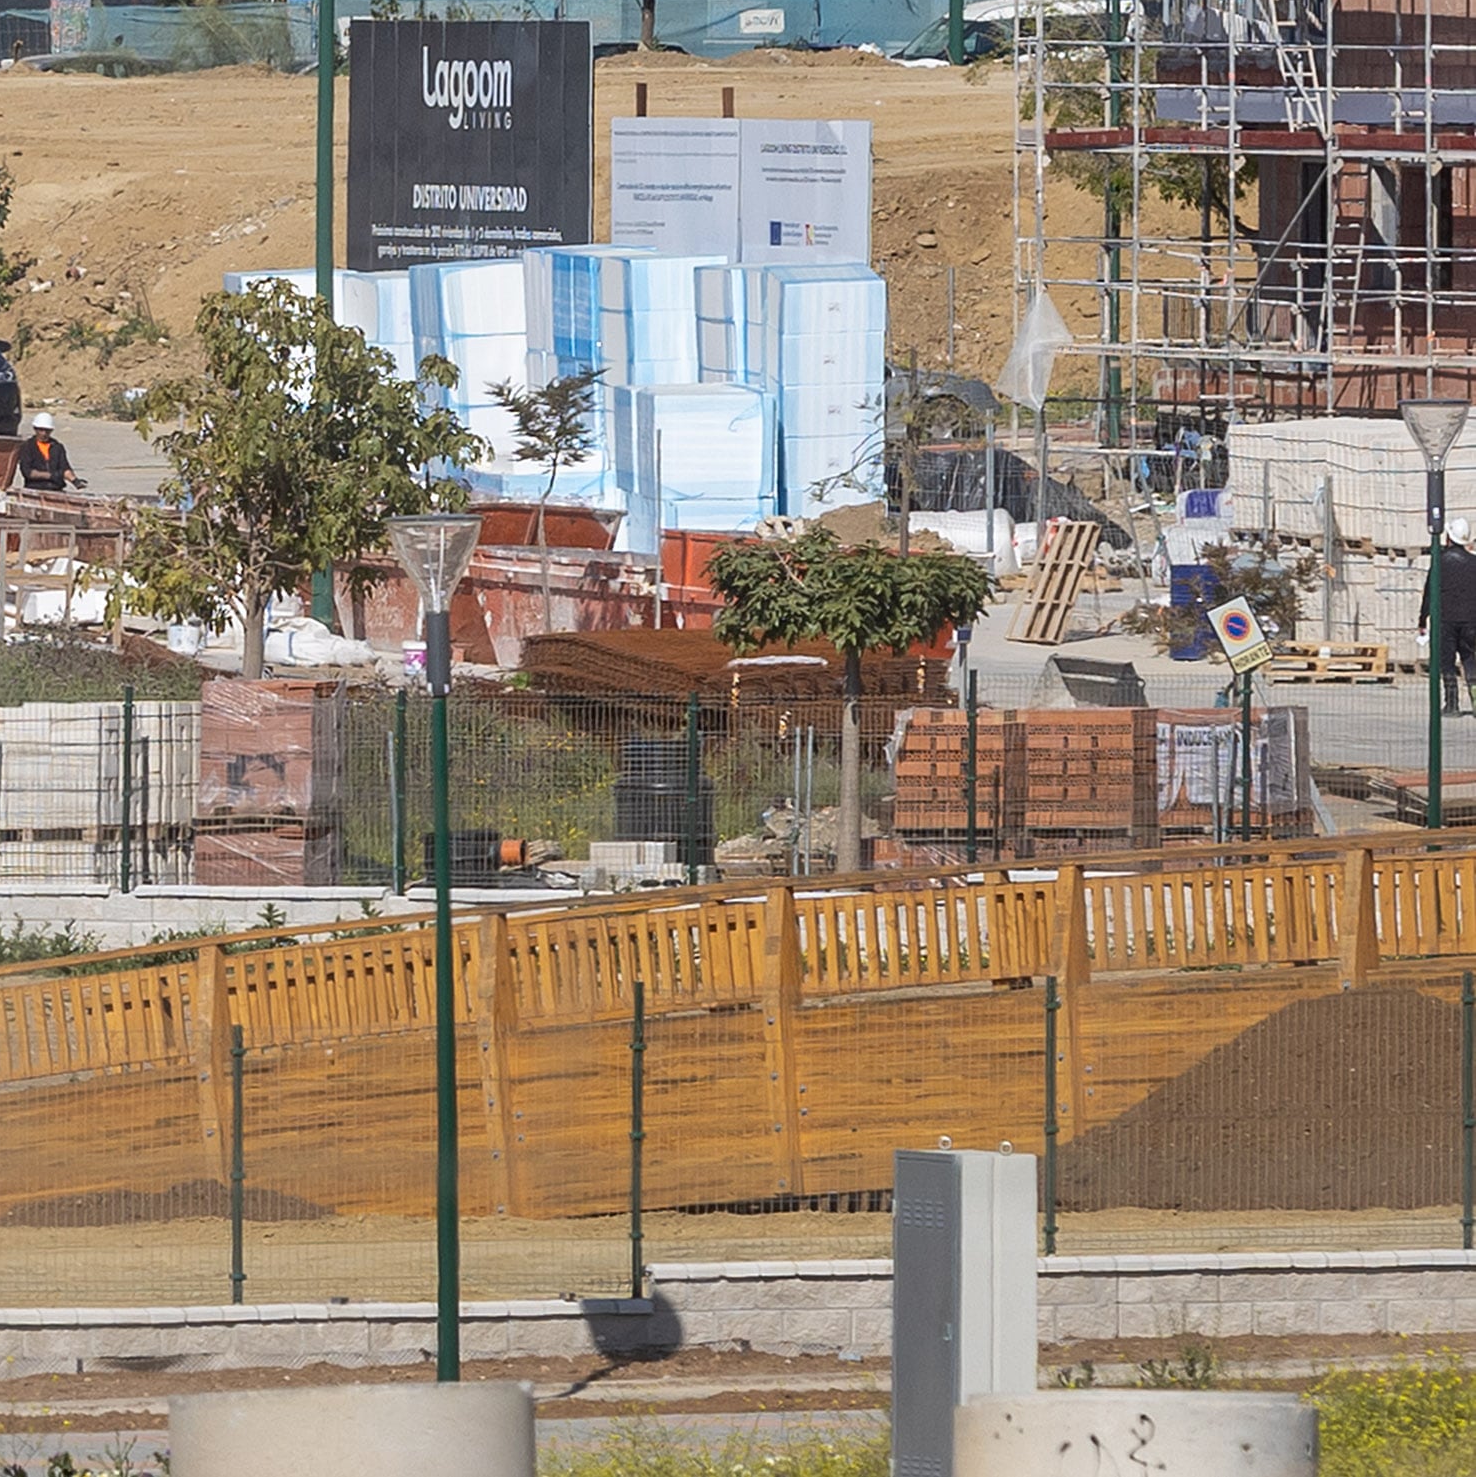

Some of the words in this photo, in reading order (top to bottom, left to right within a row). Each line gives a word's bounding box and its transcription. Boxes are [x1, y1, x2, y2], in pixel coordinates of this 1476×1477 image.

[423, 45, 512, 129] Lagoom
[464, 111, 512, 130] LIVING
[413, 184, 457, 210] DISTRITO
[458, 186, 528, 212] UNIVERSIDAD
